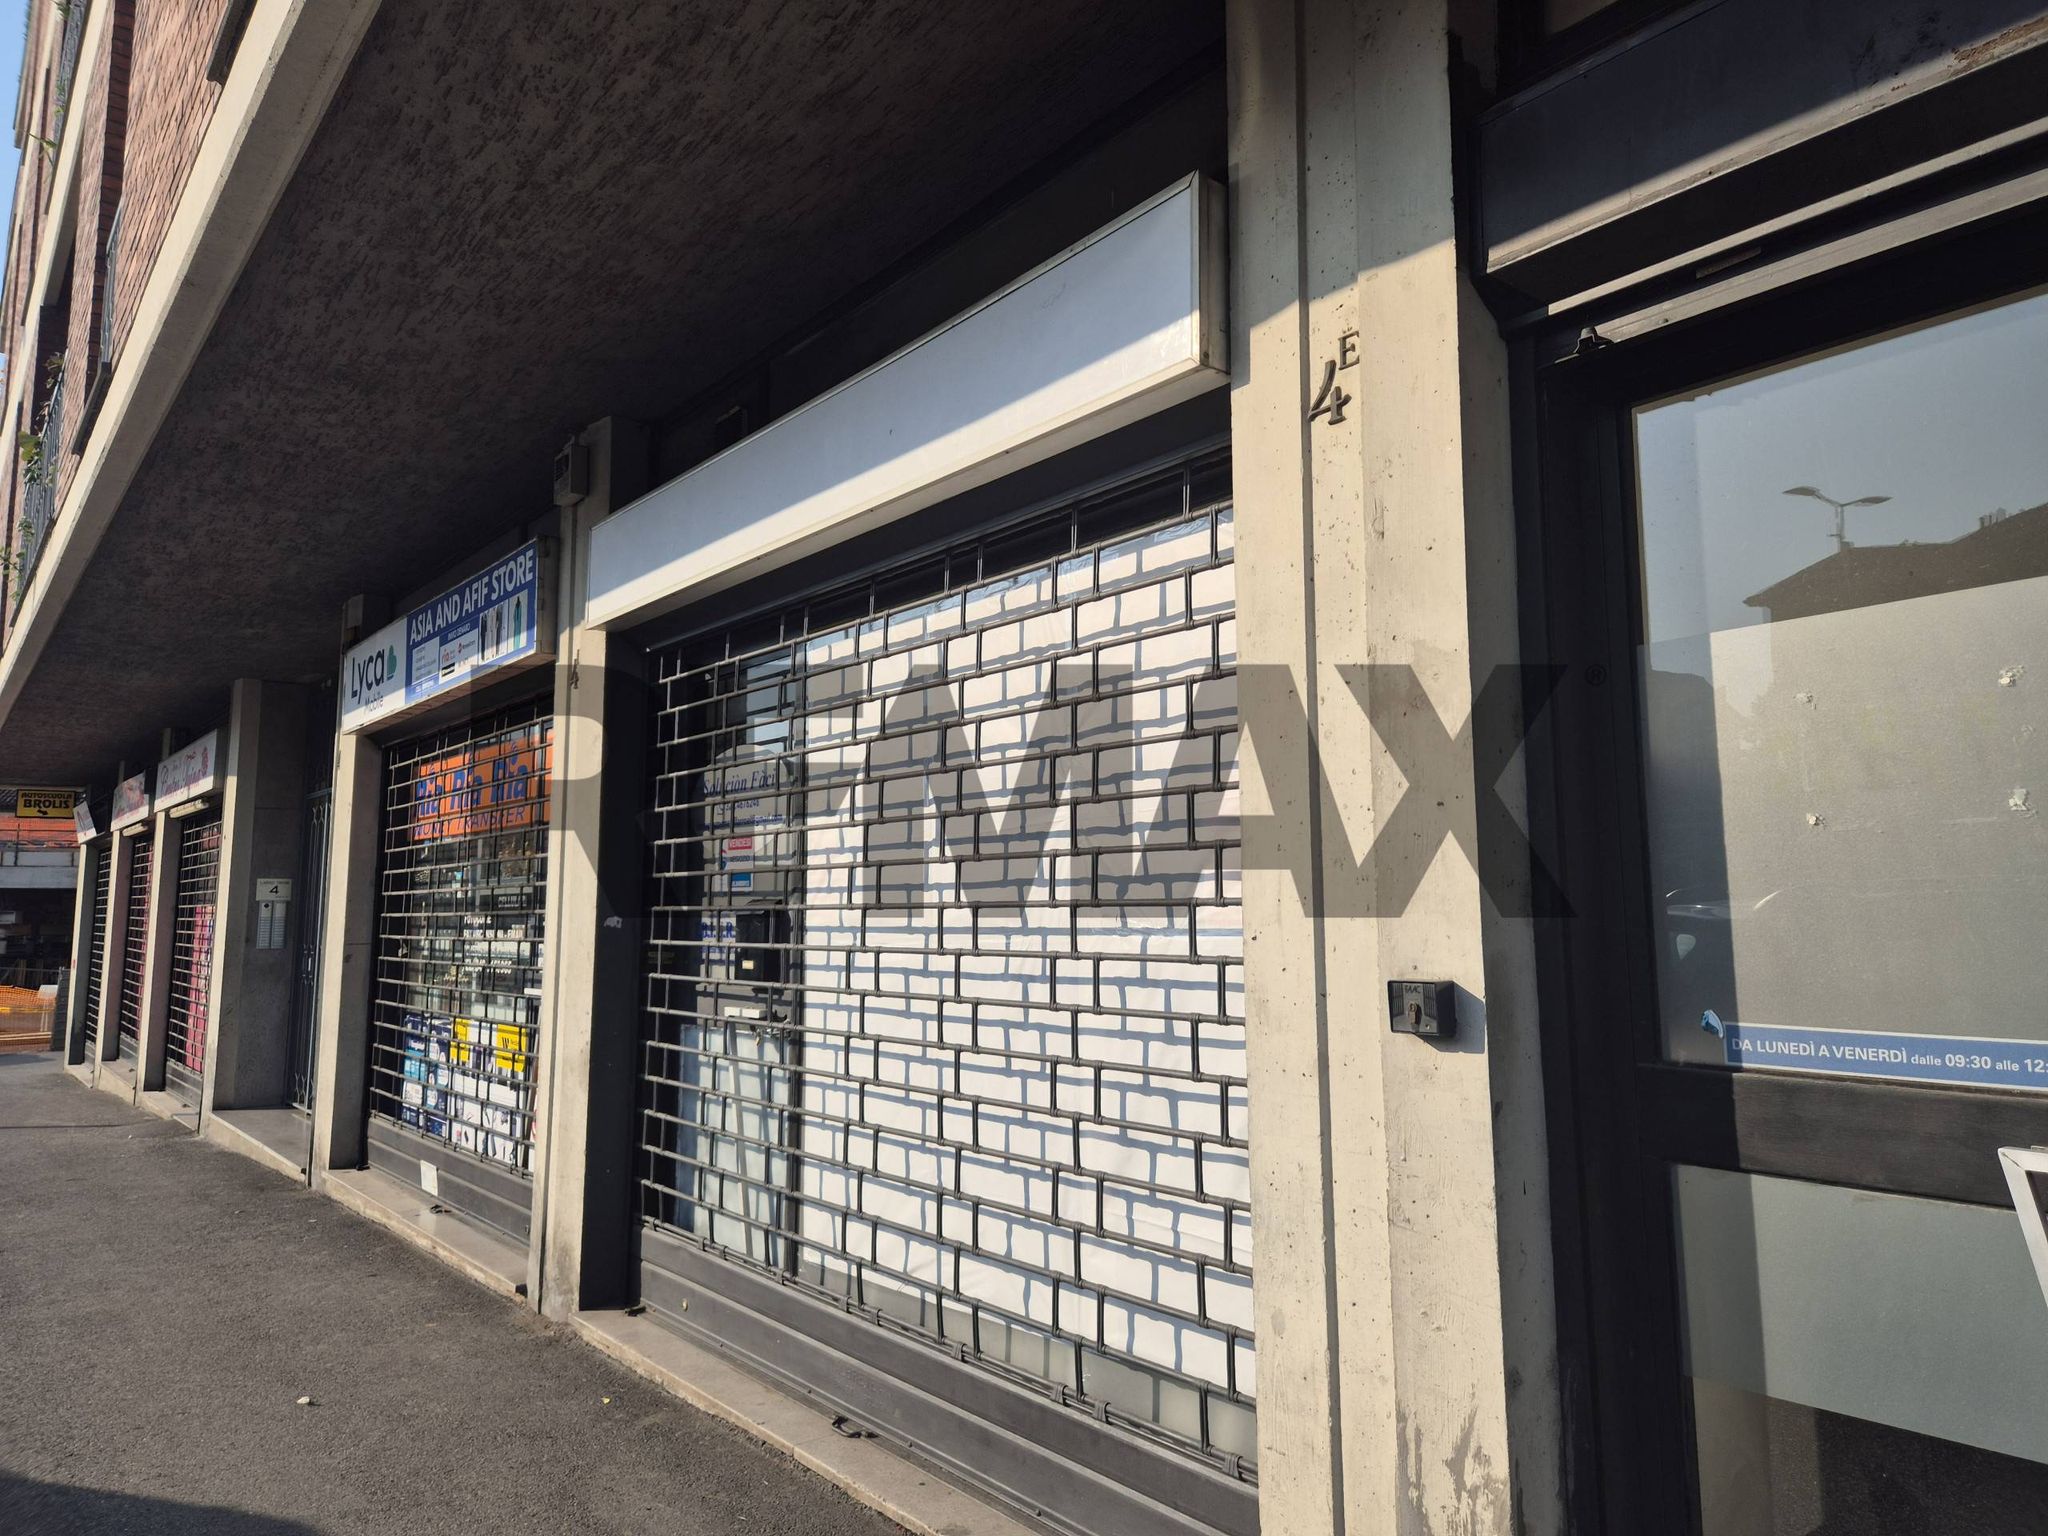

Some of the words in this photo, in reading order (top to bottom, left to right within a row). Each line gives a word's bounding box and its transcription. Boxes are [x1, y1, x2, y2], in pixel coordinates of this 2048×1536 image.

[410, 609, 433, 645] ASIA
[435, 594, 460, 631] AND
[462, 576, 489, 617] AFIF
[491, 549, 534, 600] STORE
[351, 648, 385, 705] Lyca
[365, 691, 384, 712] Mobile
[23, 799, 70, 809] BROLIS
[269, 885, 279, 895] 4
[1731, 1038, 1752, 1051] DA
[1756, 1040, 1815, 1057] LUNEDÌ
[1818, 1046, 1830, 1058] A
[1832, 1045, 1907, 1063] VENERDÌ
[1910, 1054, 1942, 1066] dalle
[1945, 1053, 1992, 1069] 09:30
[1995, 1060, 2020, 1072] alle
